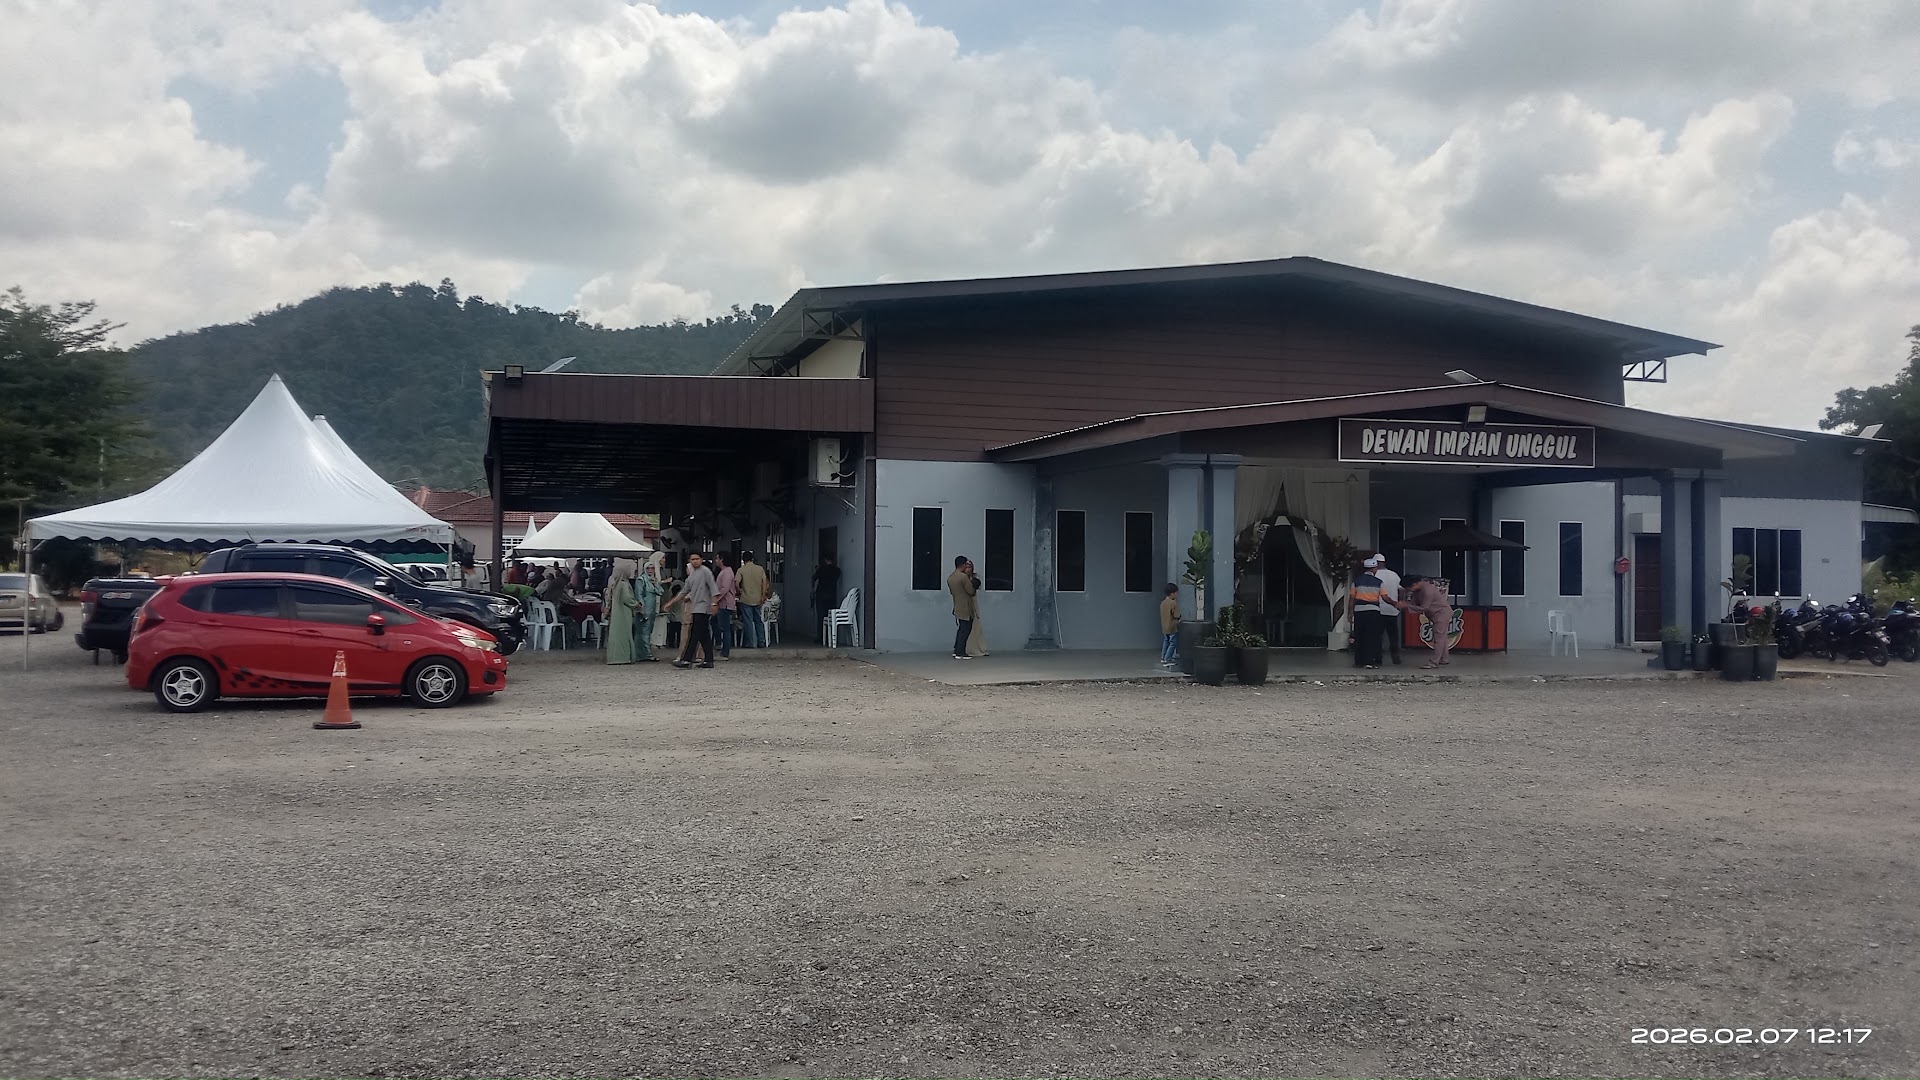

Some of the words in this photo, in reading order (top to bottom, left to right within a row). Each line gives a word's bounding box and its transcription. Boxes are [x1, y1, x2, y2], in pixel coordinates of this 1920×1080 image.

[1361, 428, 1430, 455] DEWAN
[1433, 430, 1502, 457] IMPIAN
[1505, 432, 1577, 460] UNGGUL
